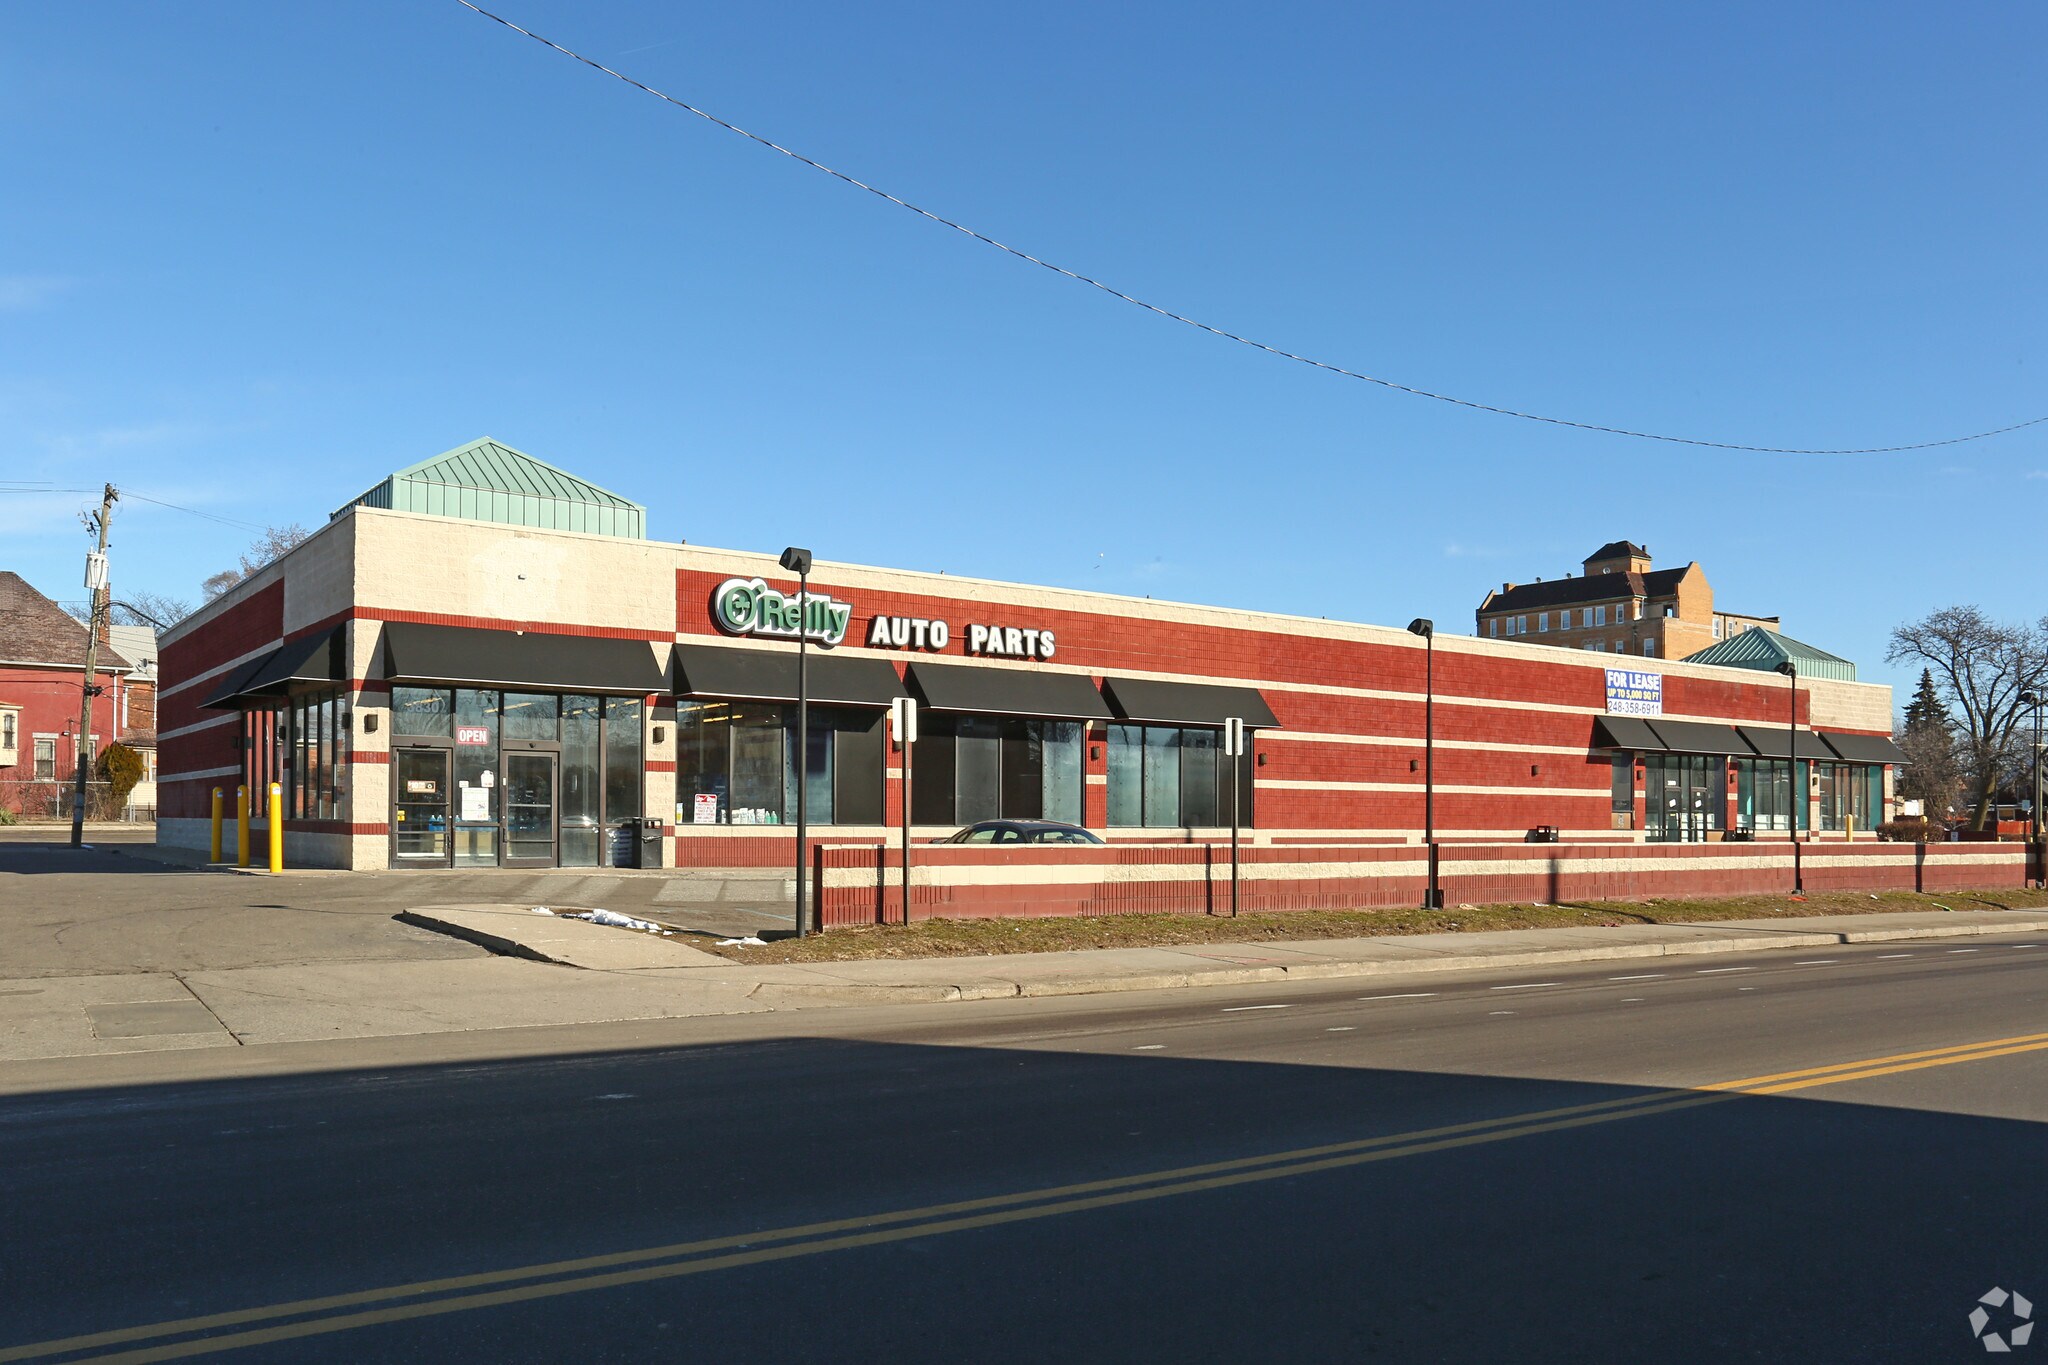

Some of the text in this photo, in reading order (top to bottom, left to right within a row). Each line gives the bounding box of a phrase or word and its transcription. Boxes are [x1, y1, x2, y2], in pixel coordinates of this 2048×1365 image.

[724, 583, 849, 639] O'Reilly
[870, 615, 1056, 659] AUTO PARTS
[1607, 671, 1660, 690] FOR LEASE
[1607, 688, 1616, 697] UP
[1617, 689, 1626, 699] TO
[1643, 691, 1652, 701] SQ
[1652, 692, 1660, 701] FT
[458, 729, 486, 743] OPEN
